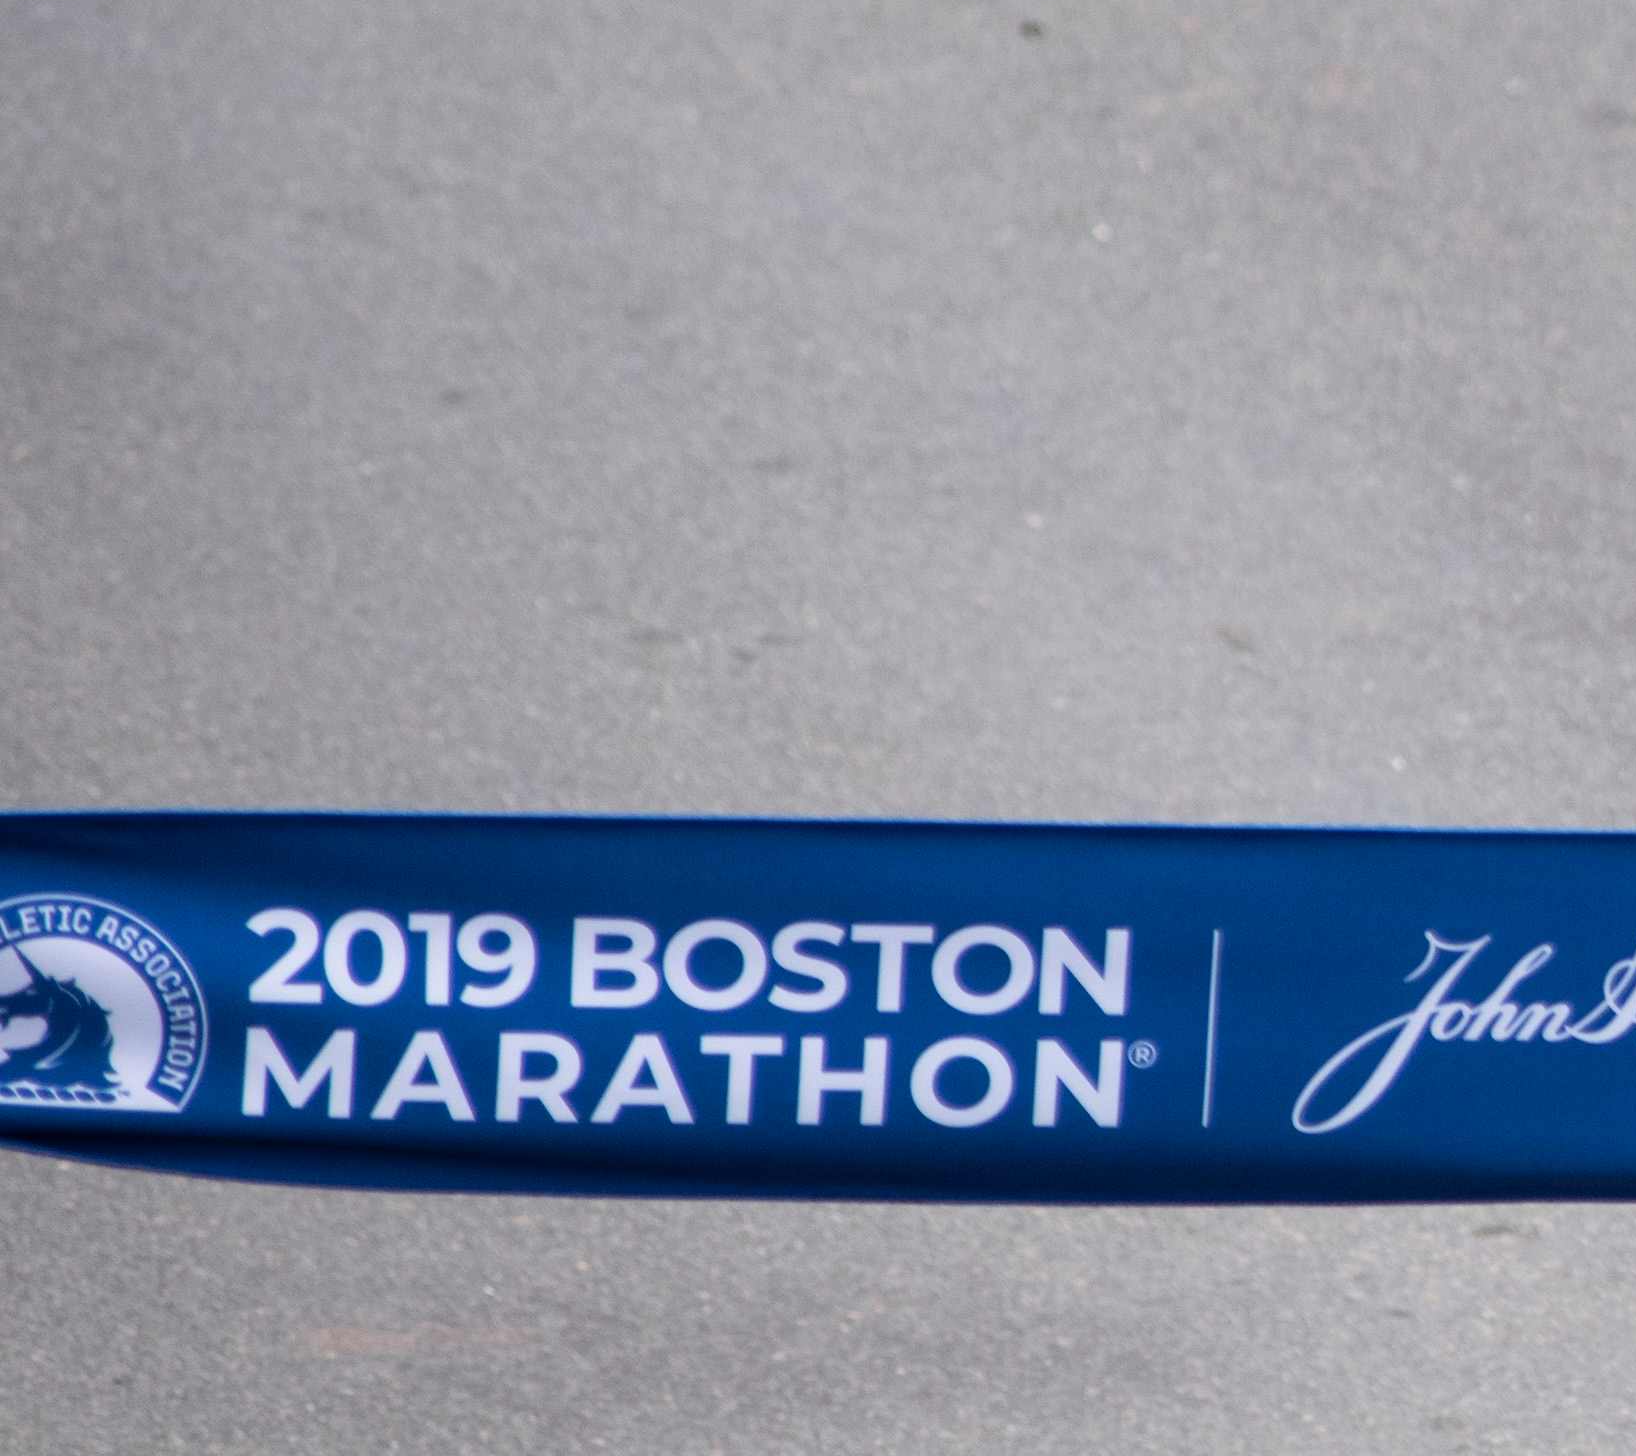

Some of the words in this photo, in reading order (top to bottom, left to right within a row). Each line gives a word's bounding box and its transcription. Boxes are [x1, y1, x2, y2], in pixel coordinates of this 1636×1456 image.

[95, 914, 198, 1092] ASSOCIATION
[244, 907, 539, 1008] 2019
[569, 915, 1131, 1018] BOSTON
[1290, 929, 1572, 1135] John
[240, 1025, 1126, 1129] MARATHON
